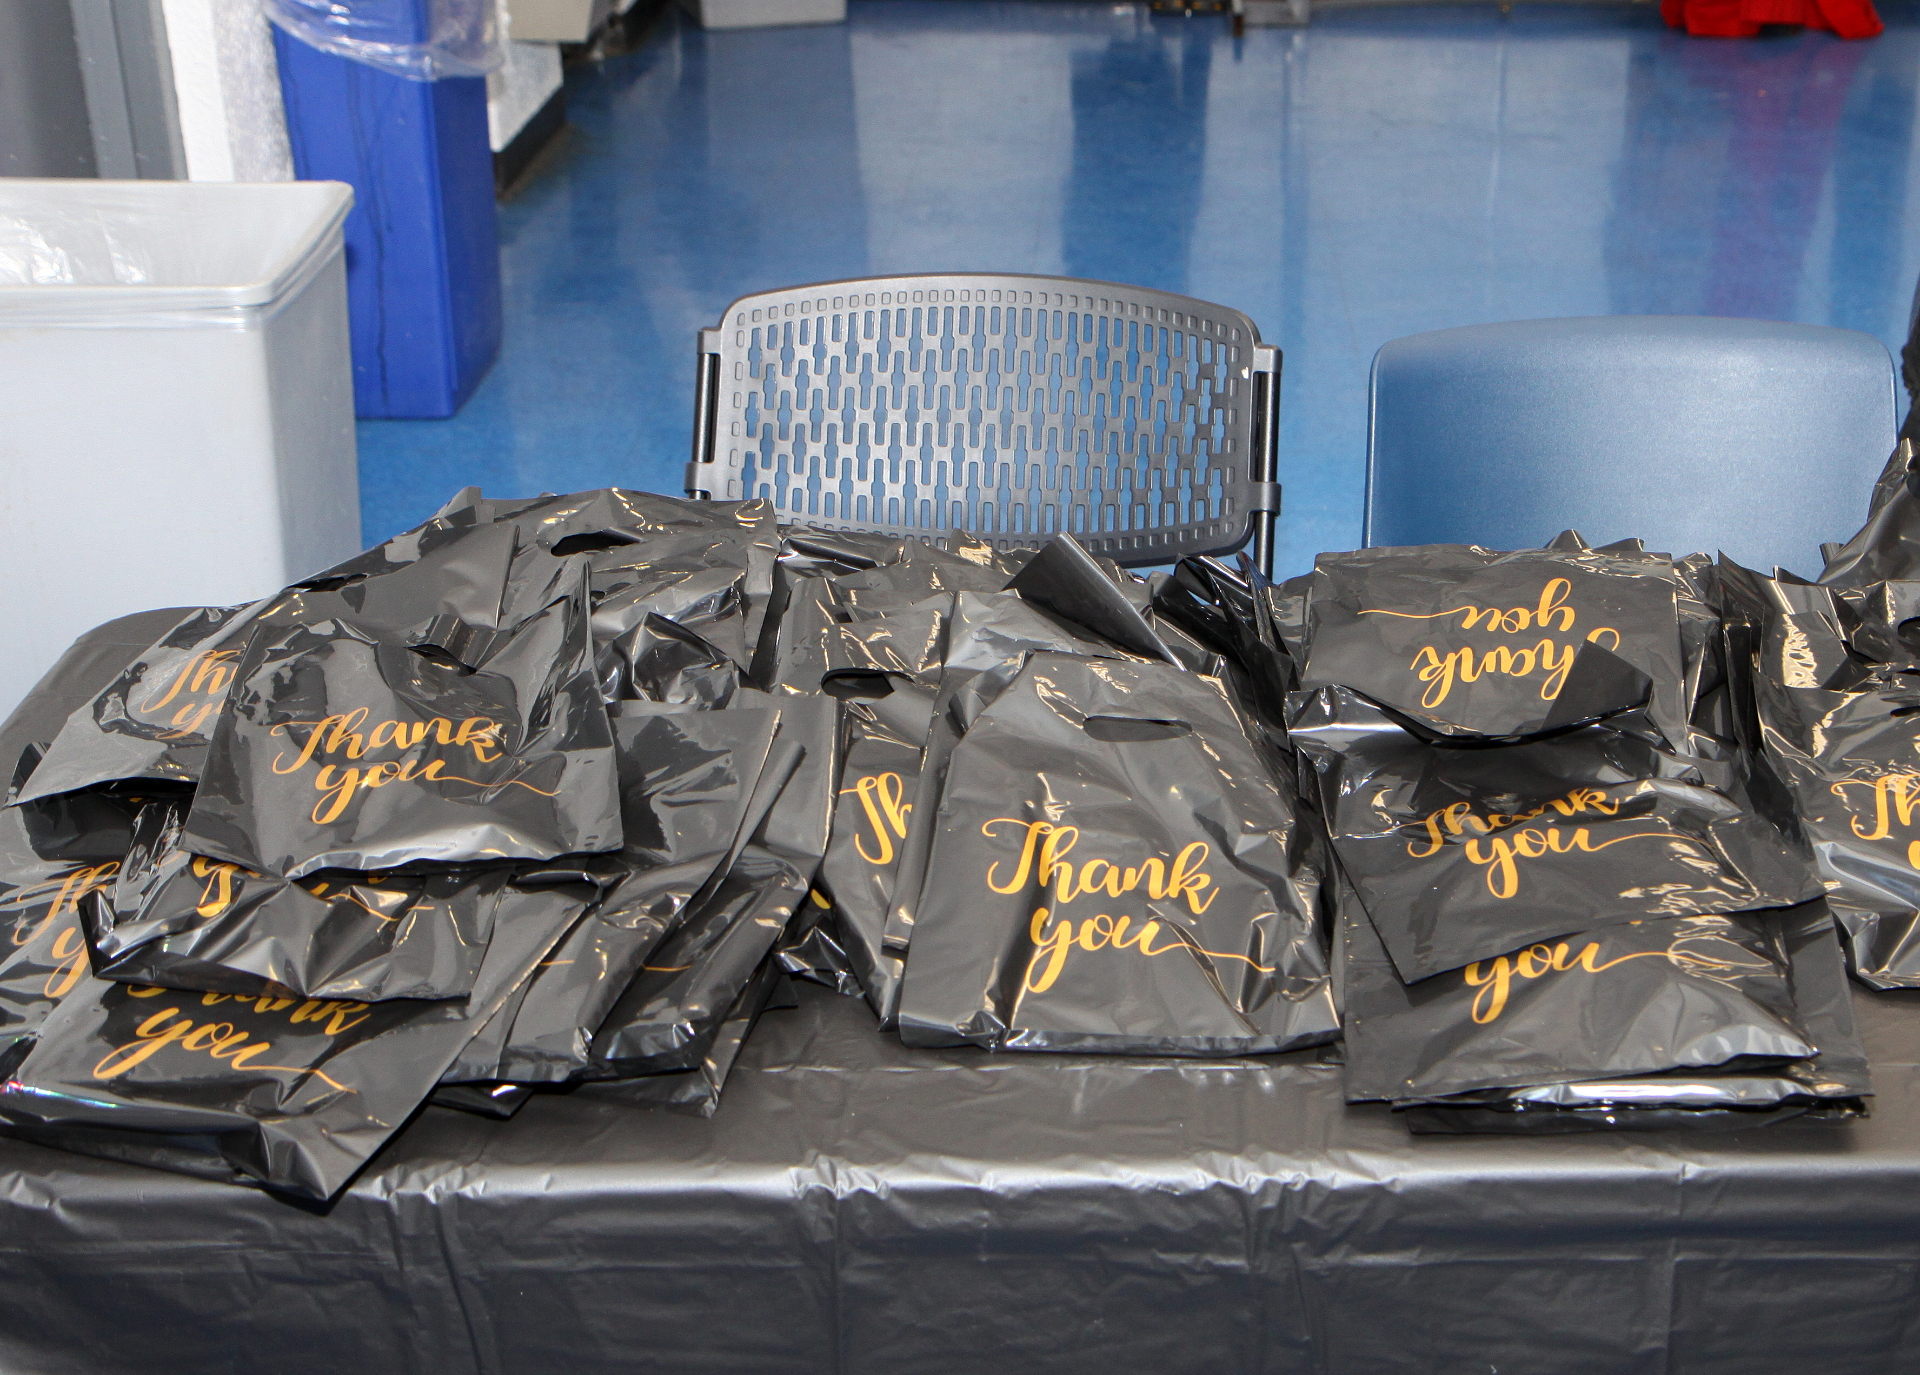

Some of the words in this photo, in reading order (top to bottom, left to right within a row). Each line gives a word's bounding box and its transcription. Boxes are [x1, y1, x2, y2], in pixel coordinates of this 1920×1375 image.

[1357, 578, 1575, 633] you
[1410, 627, 1620, 708] hank
[270, 707, 502, 775] Thank
[312, 759, 561, 825] you
[982, 818, 1219, 914] Thank
[1465, 828, 1716, 899] you
[1026, 908, 1276, 993] you
[1464, 942, 1733, 1024] you
[93, 1007, 357, 1094] you
